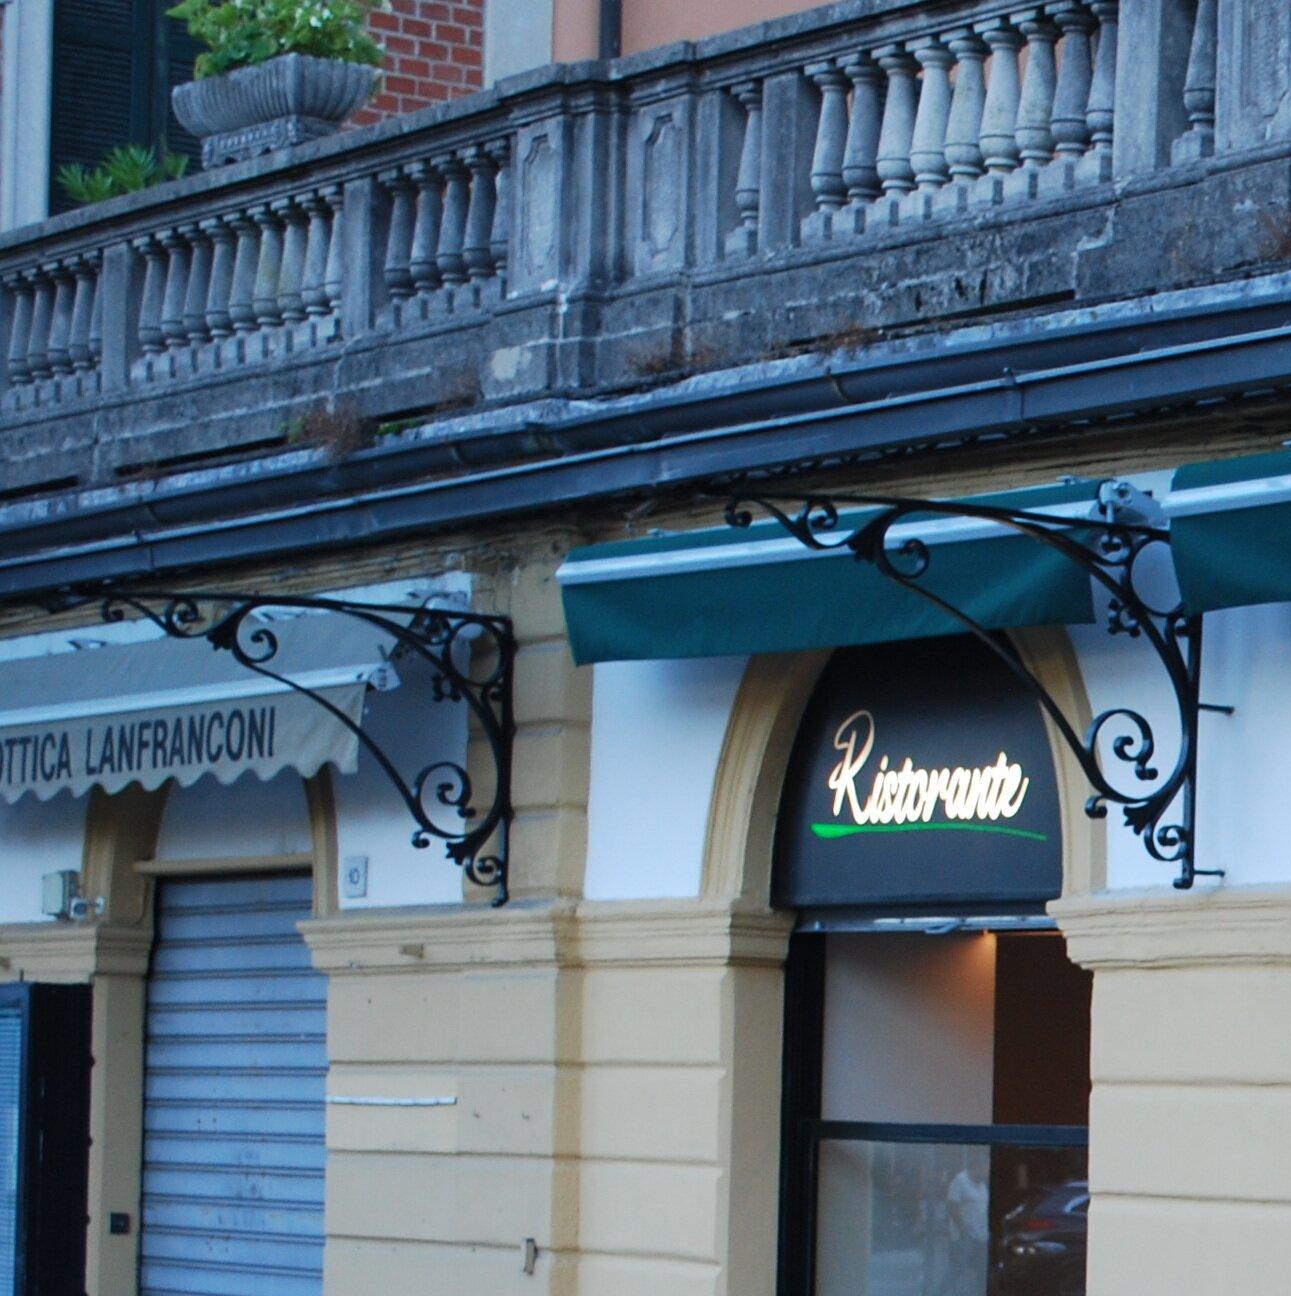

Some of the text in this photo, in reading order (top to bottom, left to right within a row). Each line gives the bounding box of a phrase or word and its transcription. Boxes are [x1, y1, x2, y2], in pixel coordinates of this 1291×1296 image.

[0, 706, 276, 785] TTICA LANFRANCONI
[828, 710, 1030, 825] Ristorante
